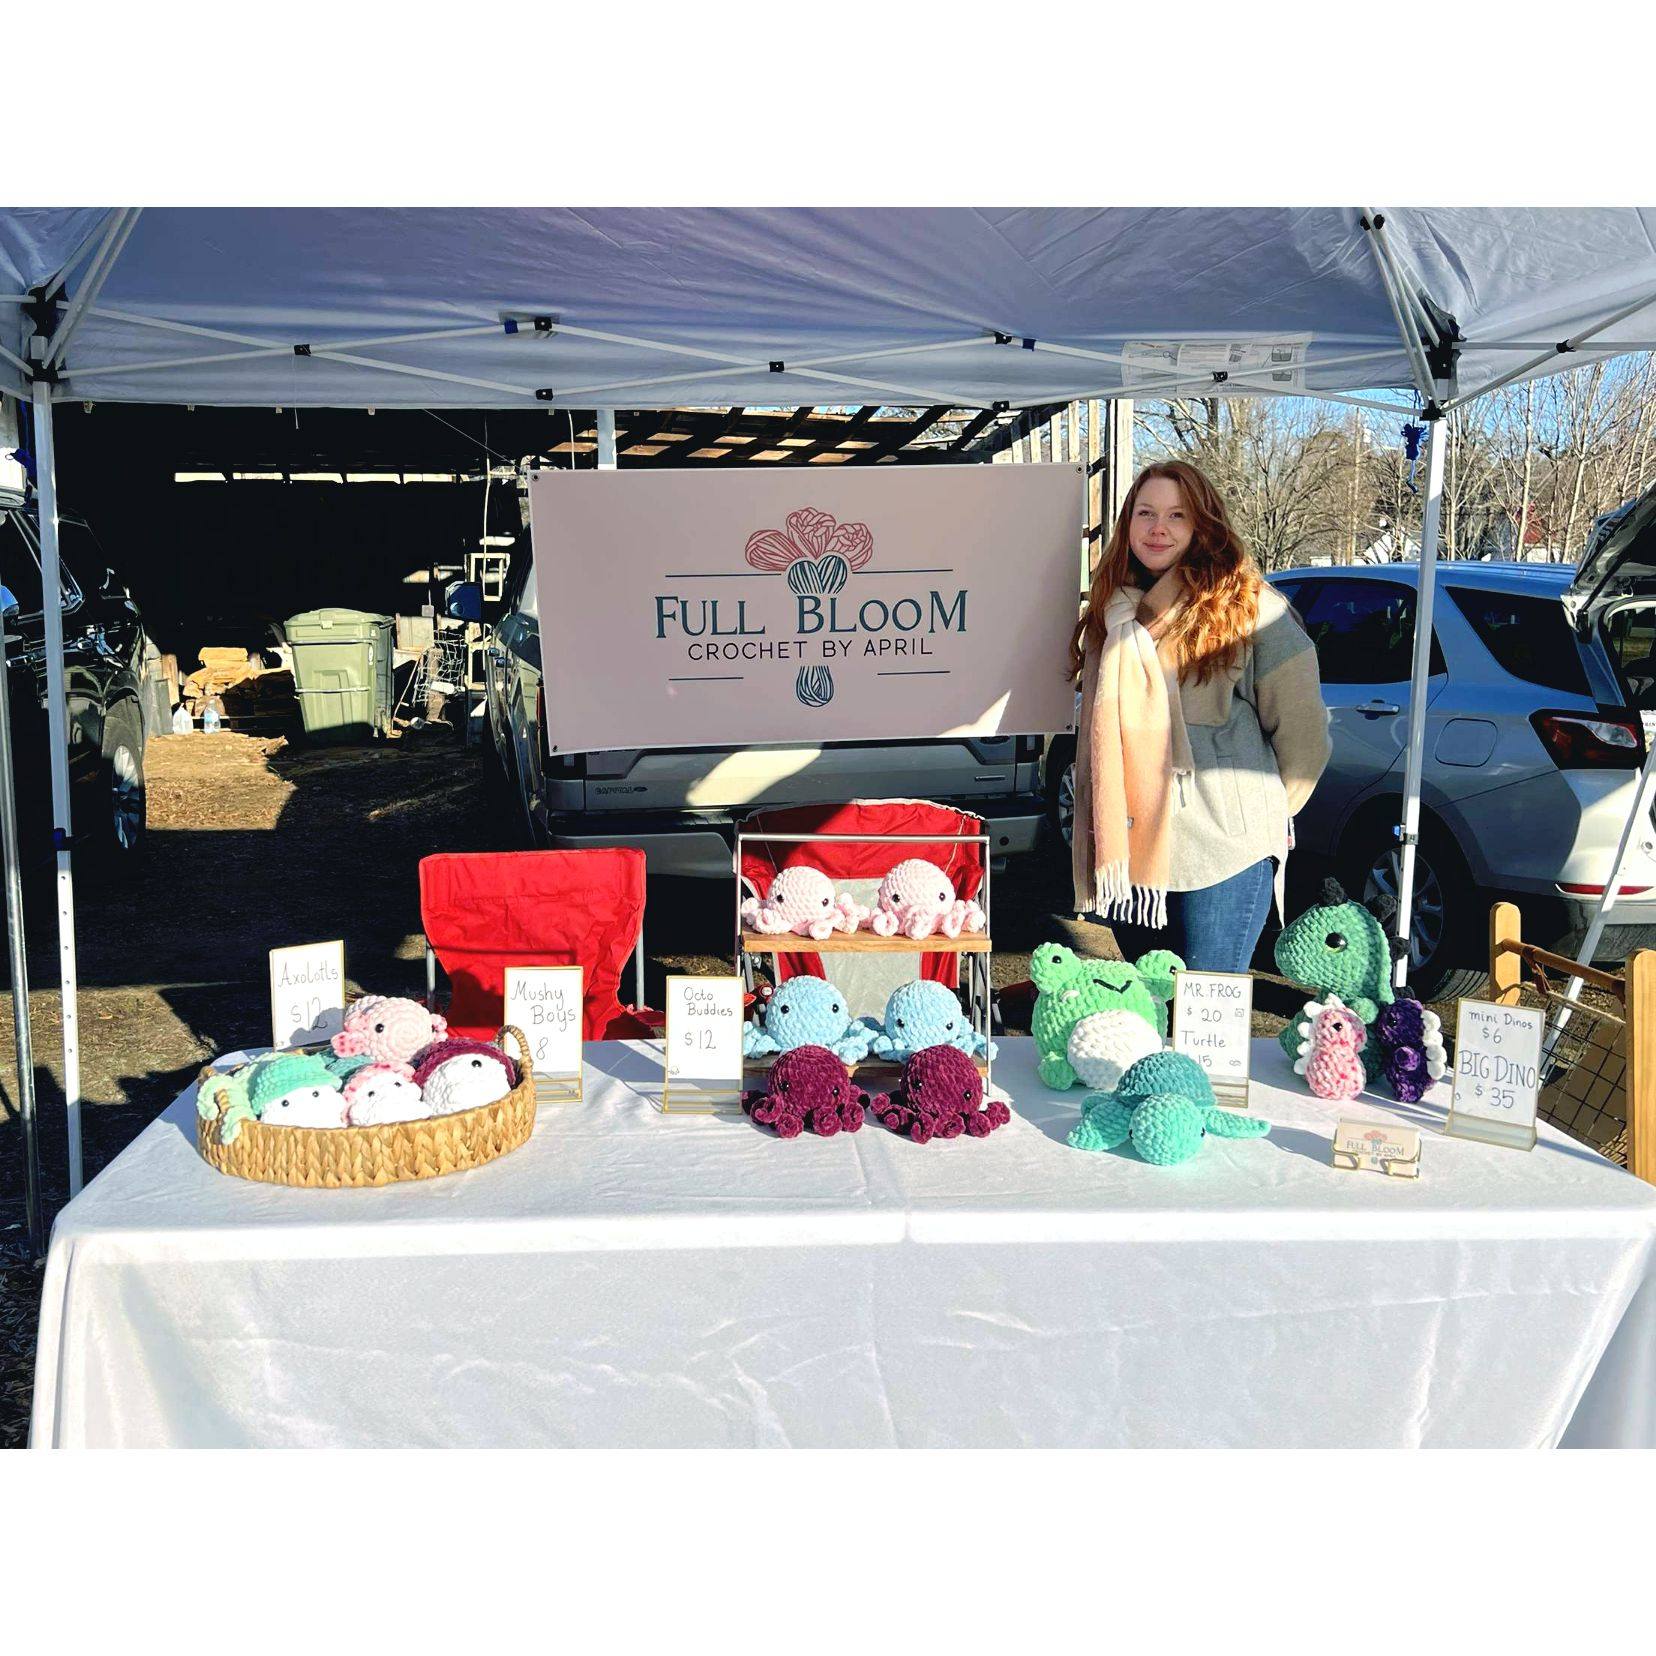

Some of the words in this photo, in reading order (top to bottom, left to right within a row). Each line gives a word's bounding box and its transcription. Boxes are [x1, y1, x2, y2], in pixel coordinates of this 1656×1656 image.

[655, 595, 766, 639] FULL
[796, 589, 969, 634] BLOOM
[688, 641, 808, 661] CROCHET
[822, 639, 852, 658] BY
[863, 637, 933, 657] APRIL
[278, 960, 339, 988] Axolotls
[510, 980, 565, 1011] Mushy
[683, 986, 714, 1001] Octo
[1209, 983, 1242, 999] FROG
[530, 1004, 576, 1033] Boys
[686, 1002, 733, 1017] Buddies
[1503, 1012, 1534, 1030] Dinos
[536, 1036, 549, 1061] 8
[1180, 1030, 1227, 1048] Turtle
[1458, 1049, 1490, 1080] BIG
[1493, 1054, 1536, 1089] DINO
